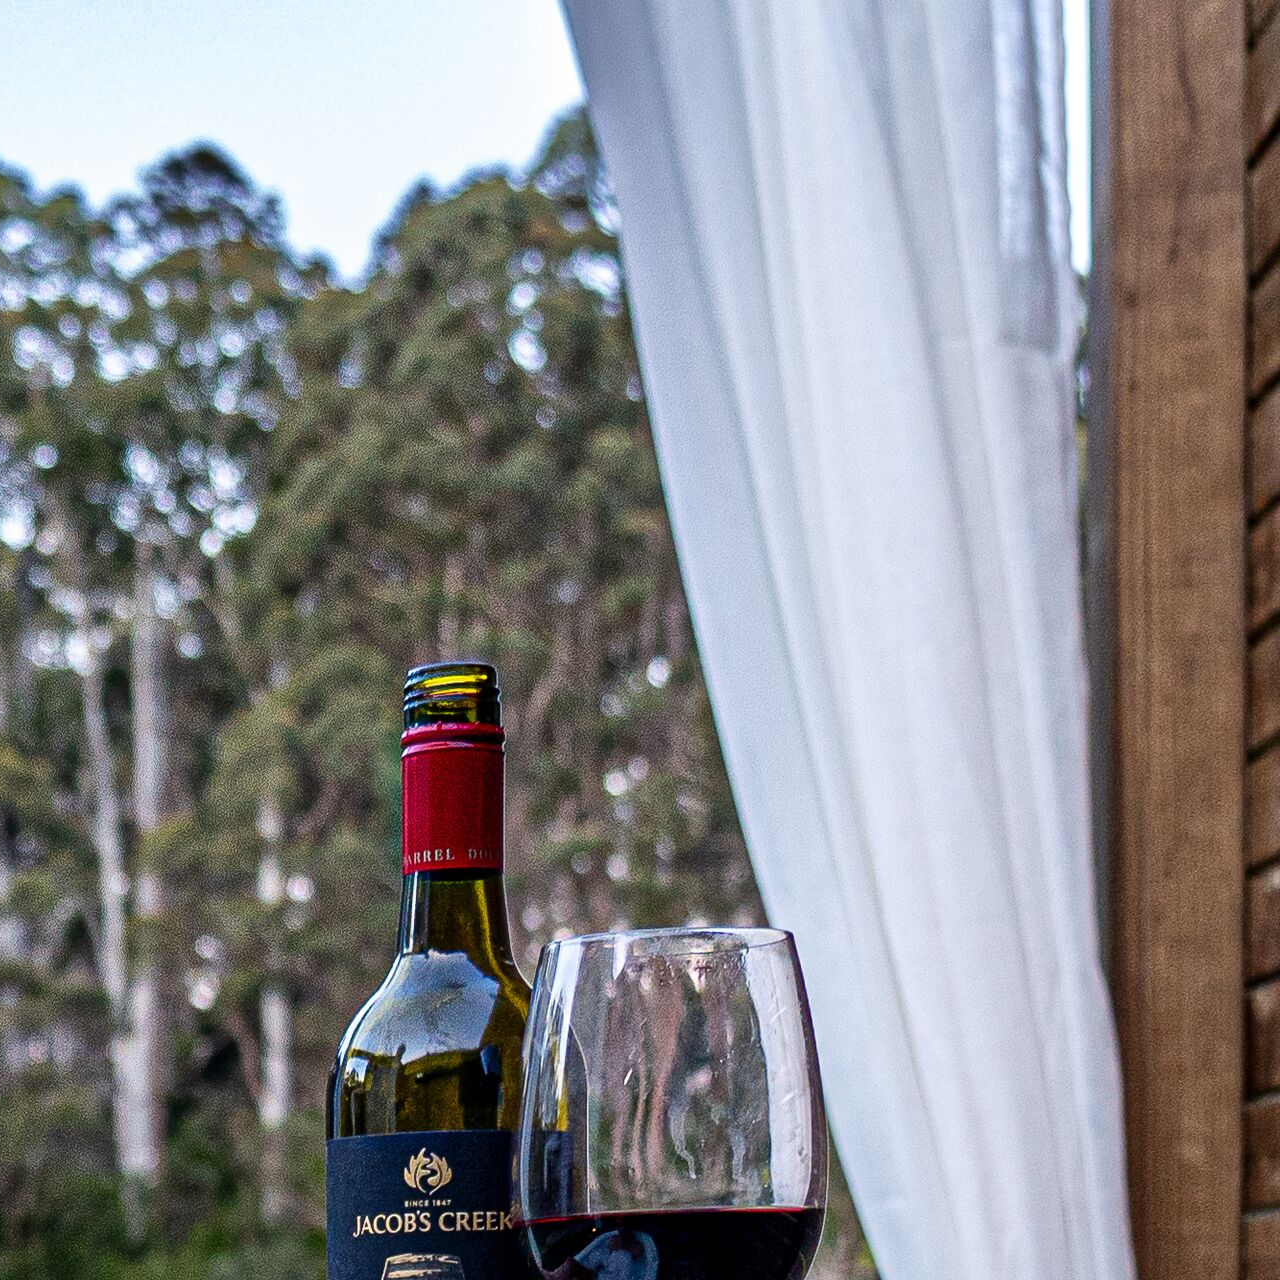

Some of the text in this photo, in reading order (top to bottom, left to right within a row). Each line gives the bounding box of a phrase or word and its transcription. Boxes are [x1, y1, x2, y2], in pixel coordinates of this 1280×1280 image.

[403, 1199, 452, 1208] SINCE 1847
[353, 1209, 515, 1238] JACOB'S CREEK
